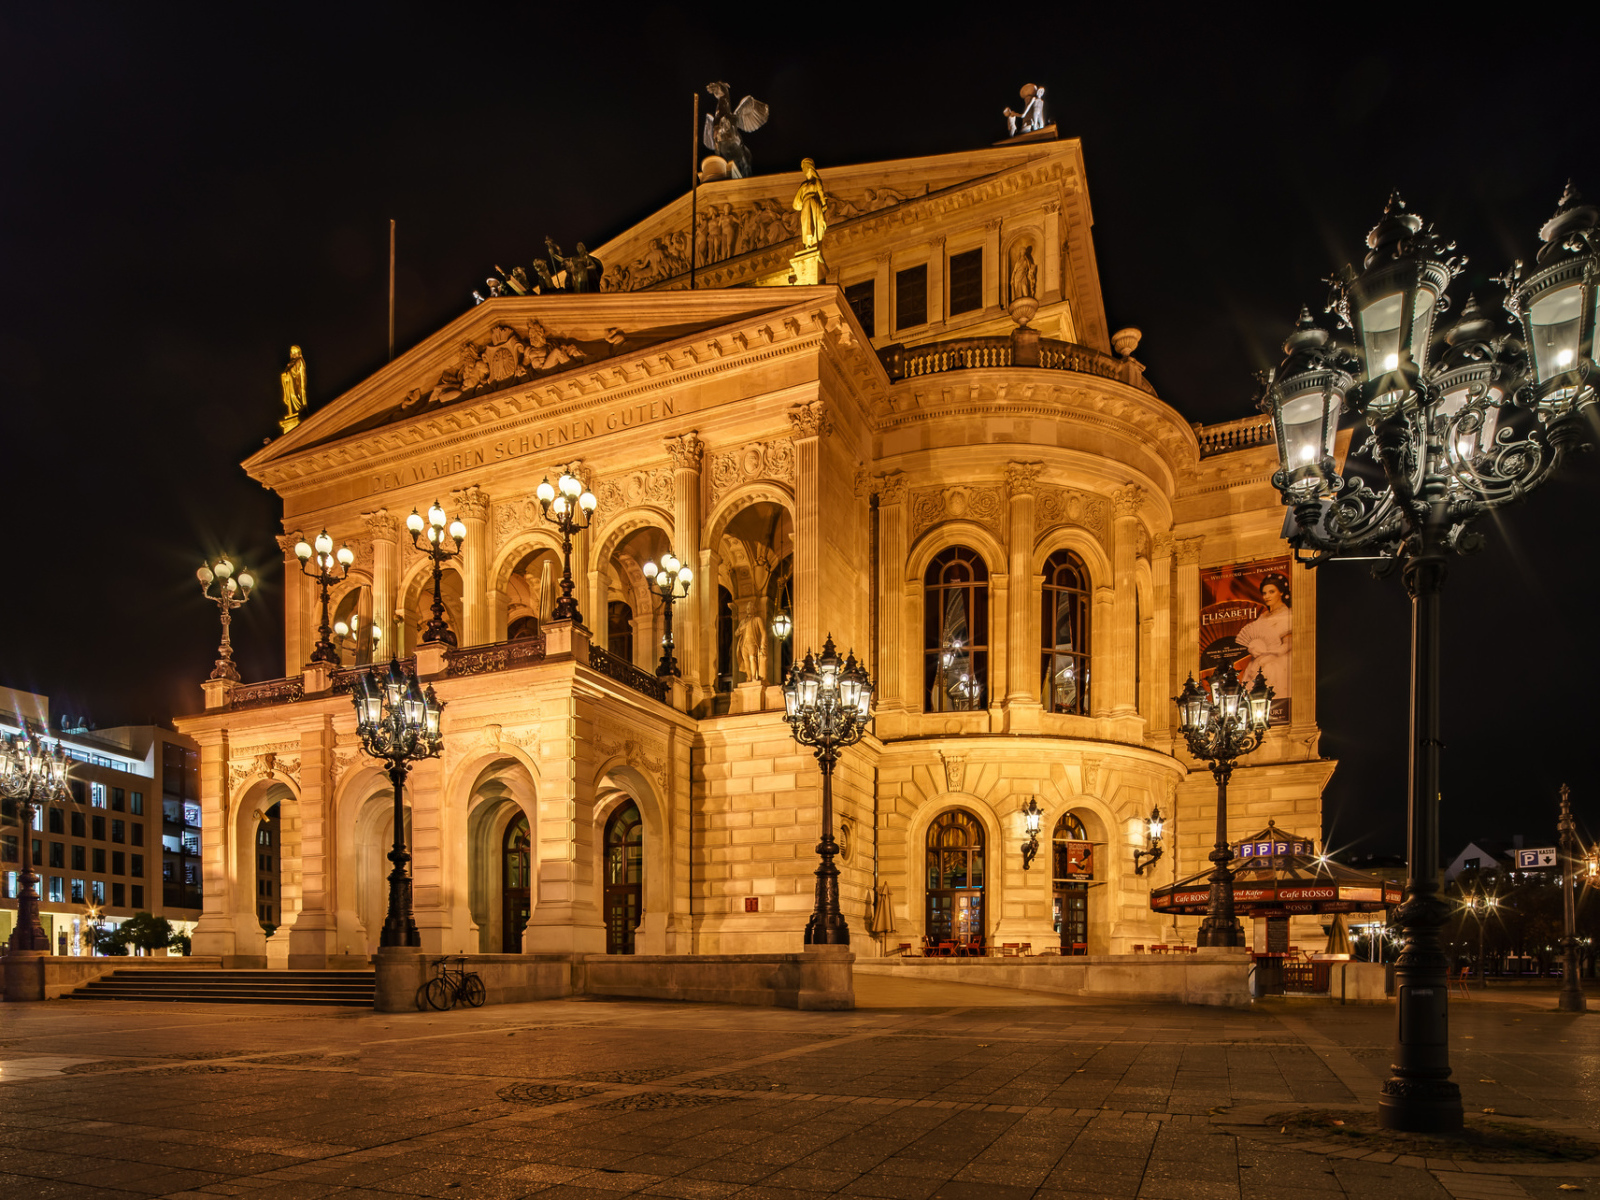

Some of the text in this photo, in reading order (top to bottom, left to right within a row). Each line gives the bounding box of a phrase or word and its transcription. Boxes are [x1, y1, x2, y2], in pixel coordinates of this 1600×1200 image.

[372, 469, 404, 493] DEM
[412, 448, 485, 482] WAHREN
[494, 418, 596, 460] SCHOENEN
[1202, 607, 1257, 626] ELISABETH
[1243, 847, 1251, 857] P
[1259, 846, 1268, 856] P
[1277, 845, 1286, 855] P
[1294, 845, 1302, 855] P
[1524, 854, 1535, 866] P
[1190, 893, 1209, 902] ROSS
[1301, 889, 1334, 898] ROSSO
